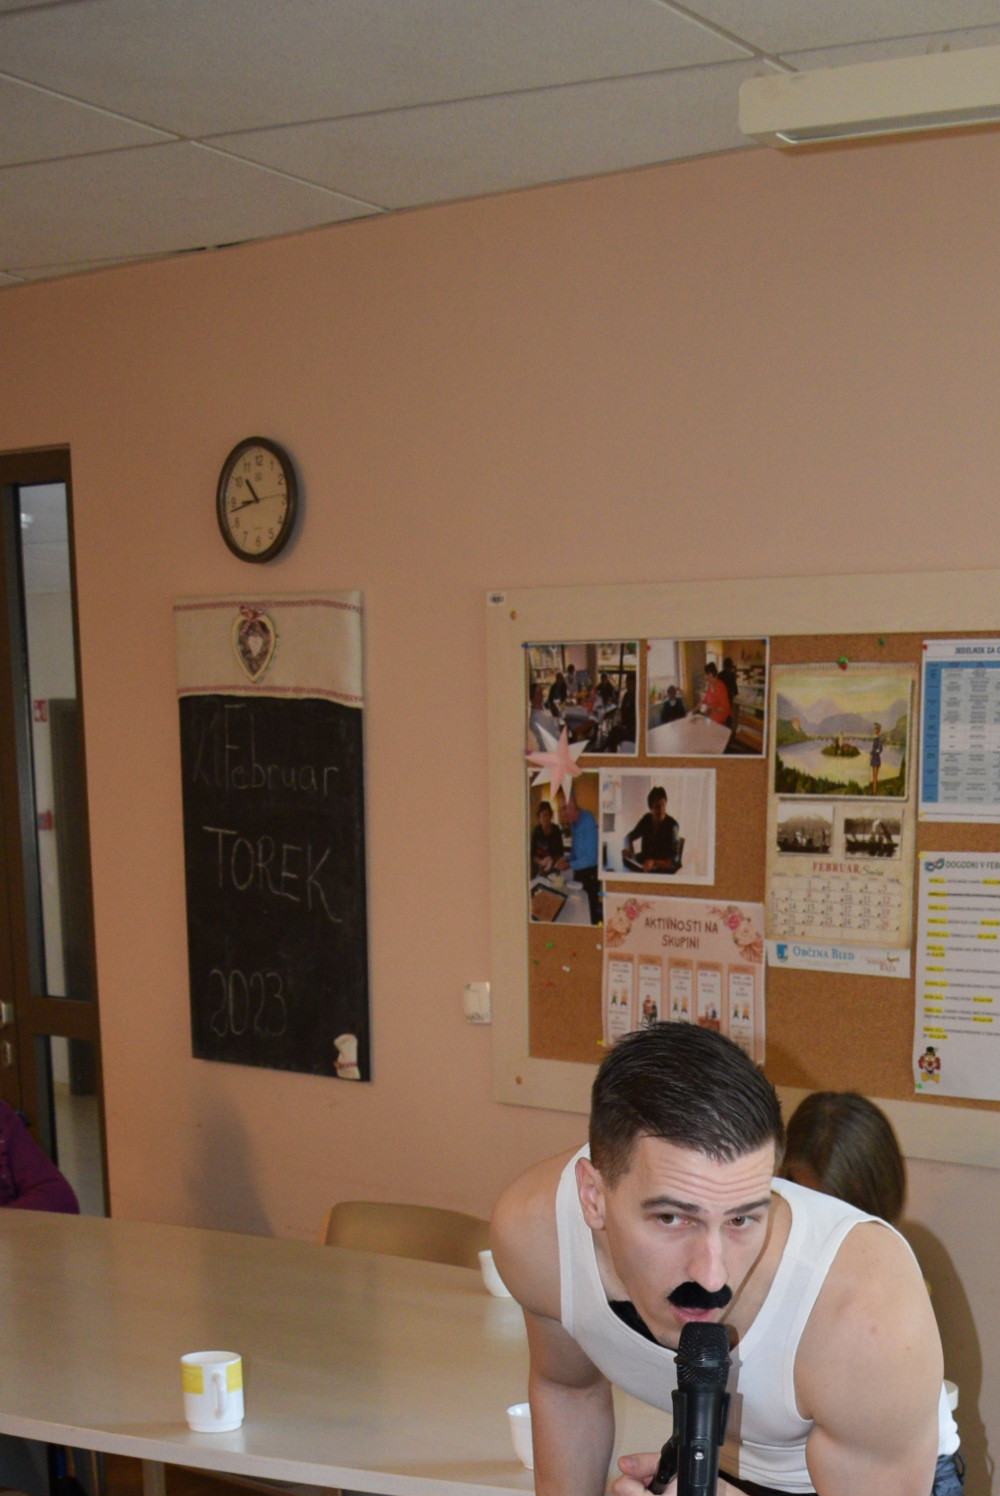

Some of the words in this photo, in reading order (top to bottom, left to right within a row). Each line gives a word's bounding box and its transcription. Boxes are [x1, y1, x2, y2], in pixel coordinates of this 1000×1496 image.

[812, 862, 860, 874] FEBRUAR
[945, 861, 979, 869] DOGODKI
[202, 826, 343, 923] TOREK
[644, 916, 702, 933] AKTIVNOSTI
[704, 921, 719, 934] NA
[661, 934, 701, 949] SKUPINI
[209, 968, 288, 1037] 2023
